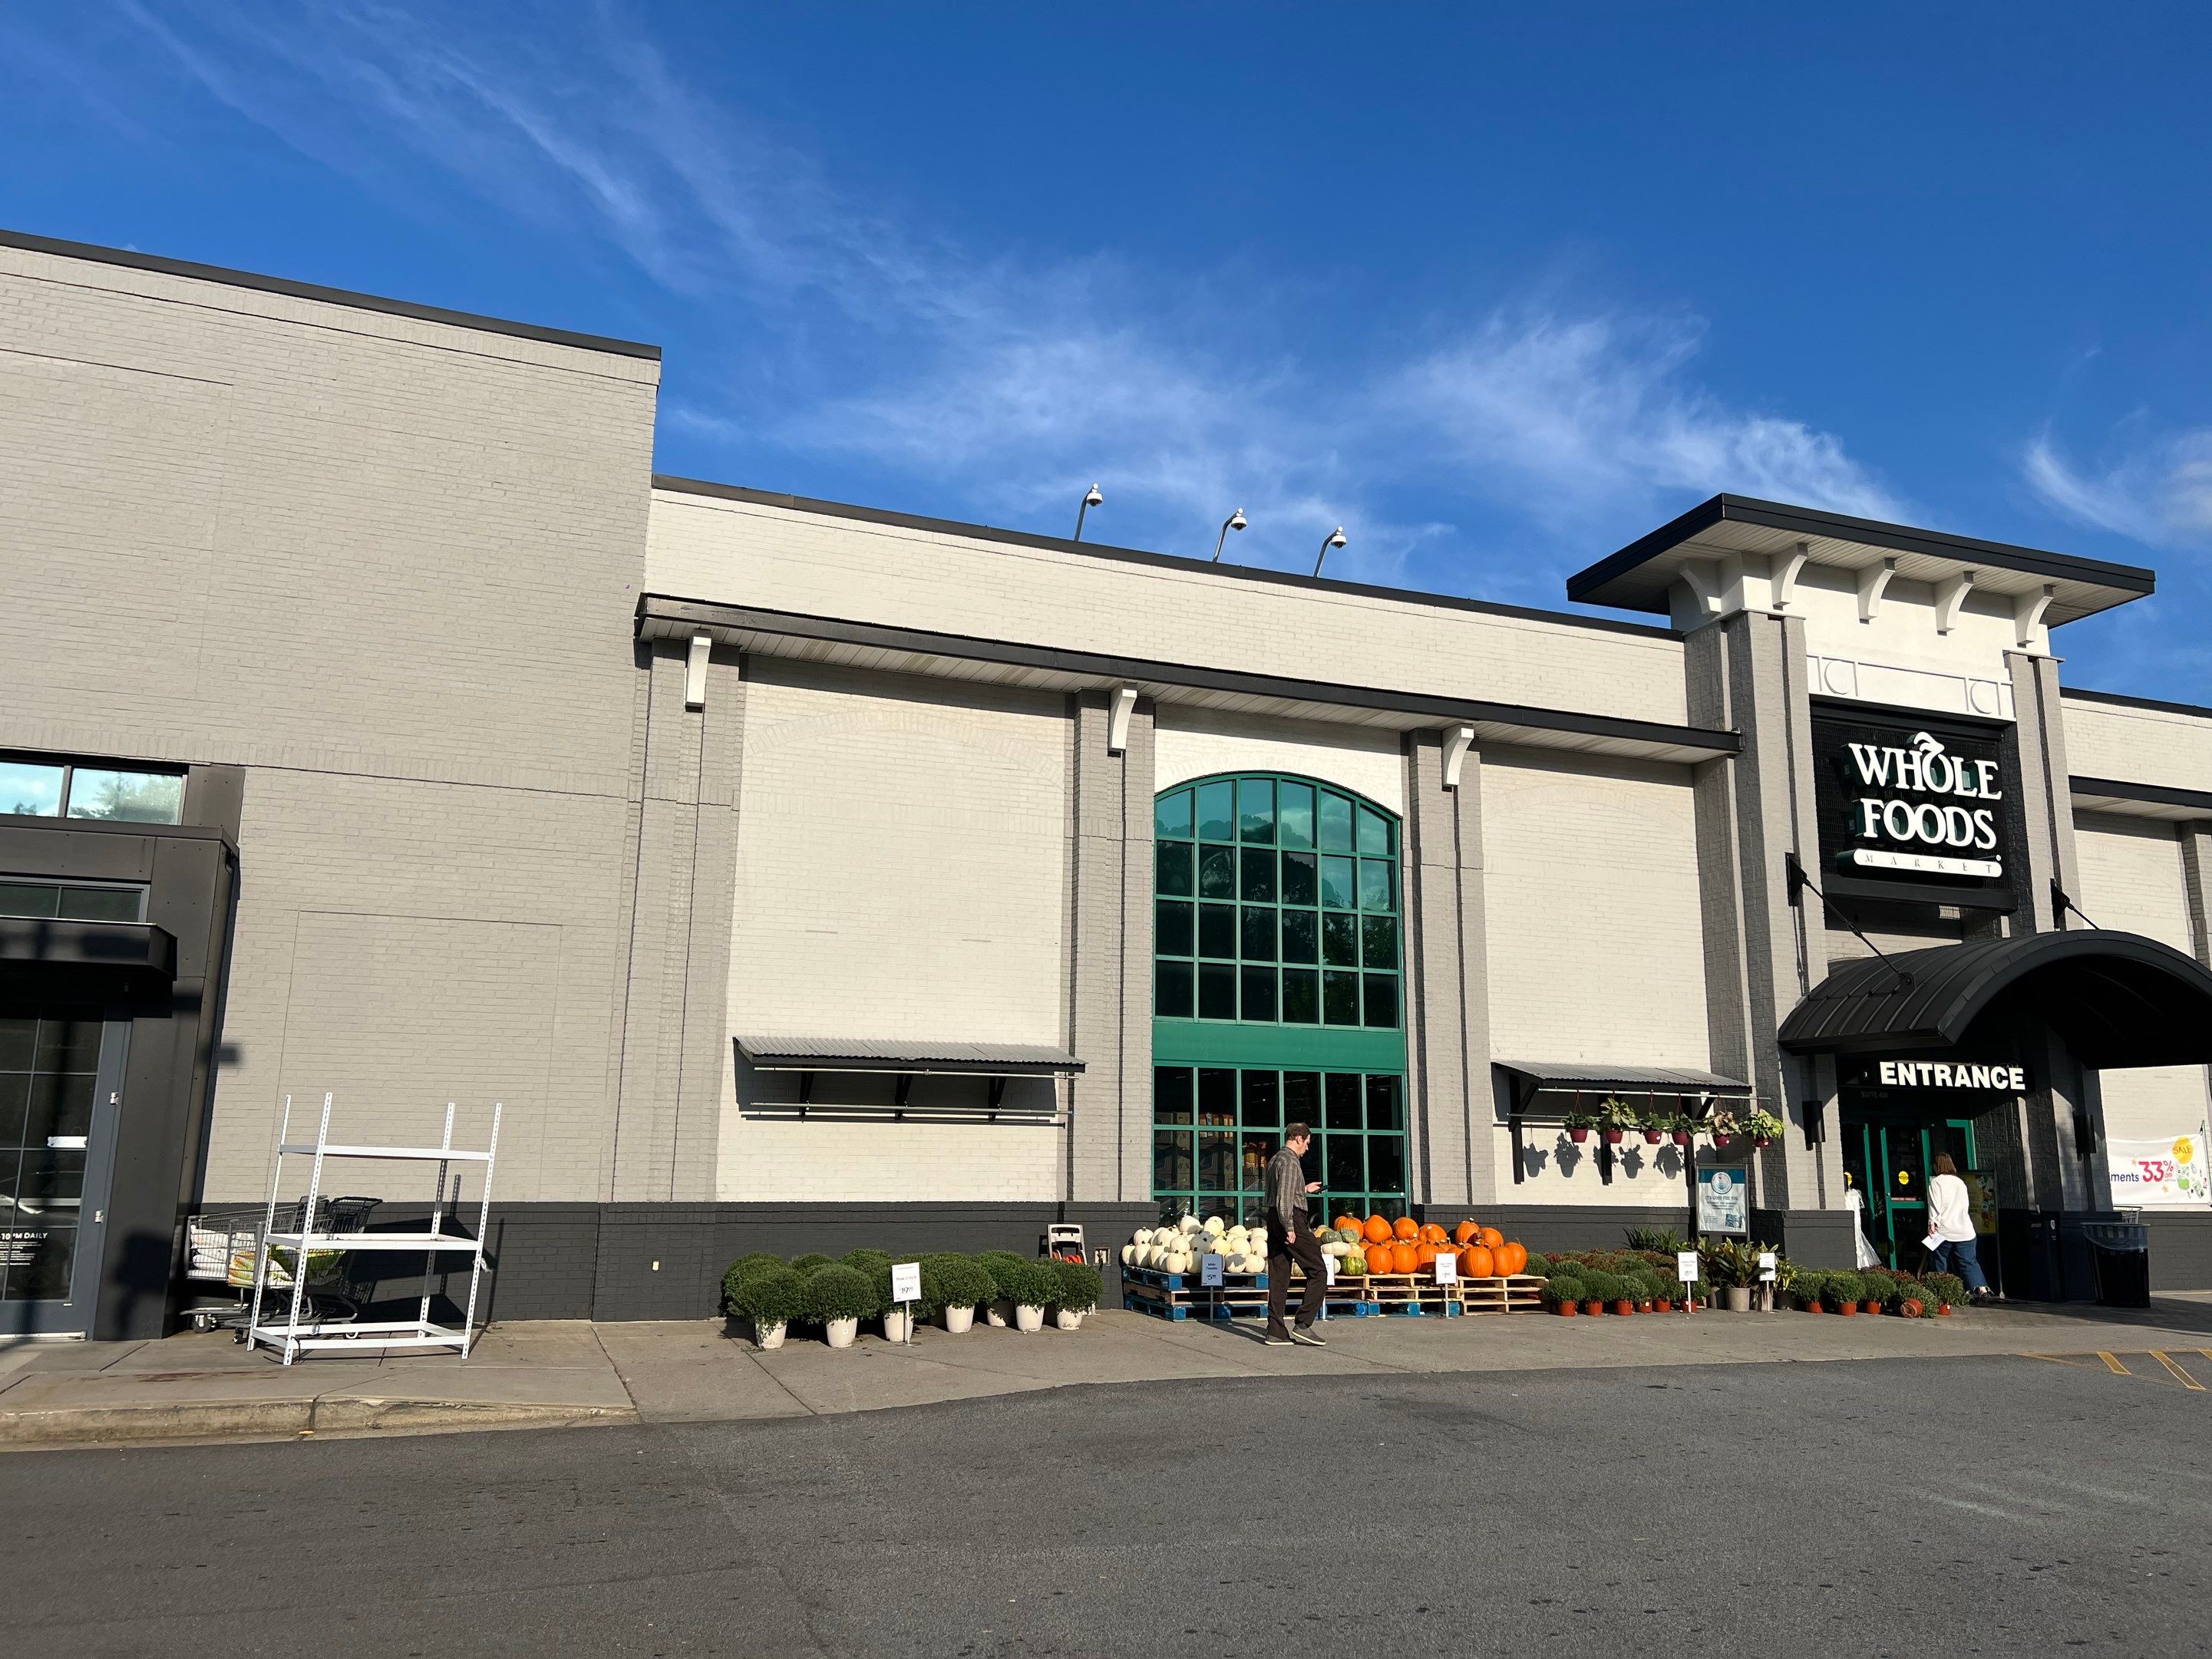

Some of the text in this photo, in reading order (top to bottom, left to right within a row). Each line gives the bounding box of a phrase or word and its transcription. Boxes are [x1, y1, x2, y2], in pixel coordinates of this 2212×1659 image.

[1848, 732, 2002, 800] WHOLE
[1860, 798, 1996, 849] FOODS
[1864, 853, 1993, 874] MARKET
[1880, 1061, 2025, 1090] ENTRANCE
[2173, 1146, 2192, 1154] SALE
